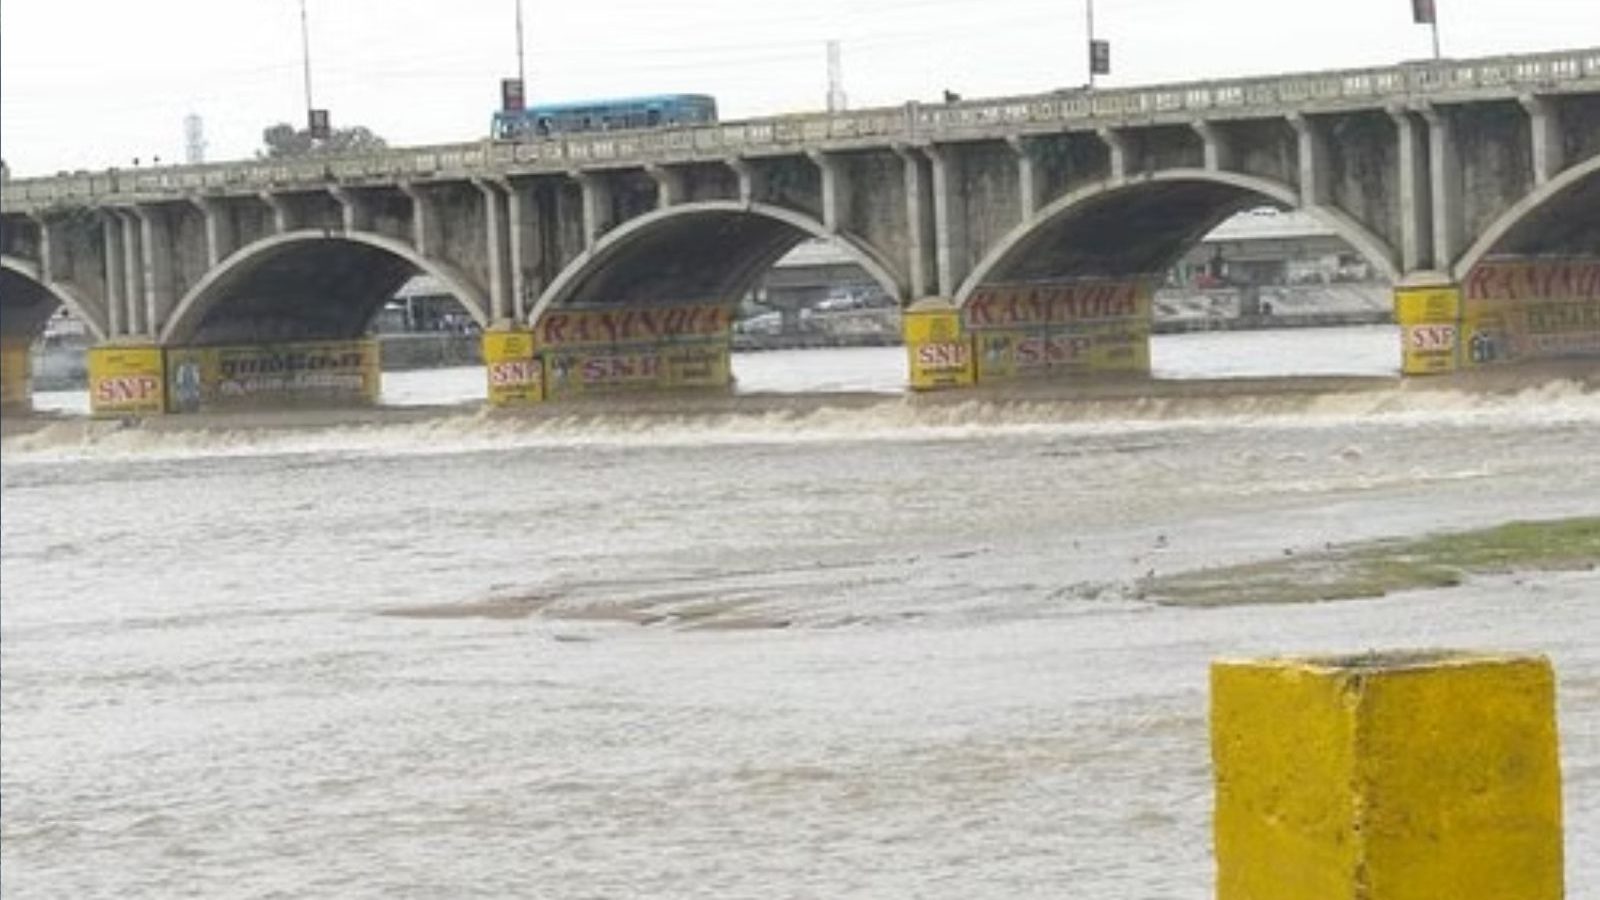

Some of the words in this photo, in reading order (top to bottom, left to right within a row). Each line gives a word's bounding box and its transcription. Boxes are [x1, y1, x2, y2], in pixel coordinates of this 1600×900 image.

[918, 343, 967, 367] SNP
[492, 361, 541, 384] SNP
[98, 378, 157, 400] SNP
